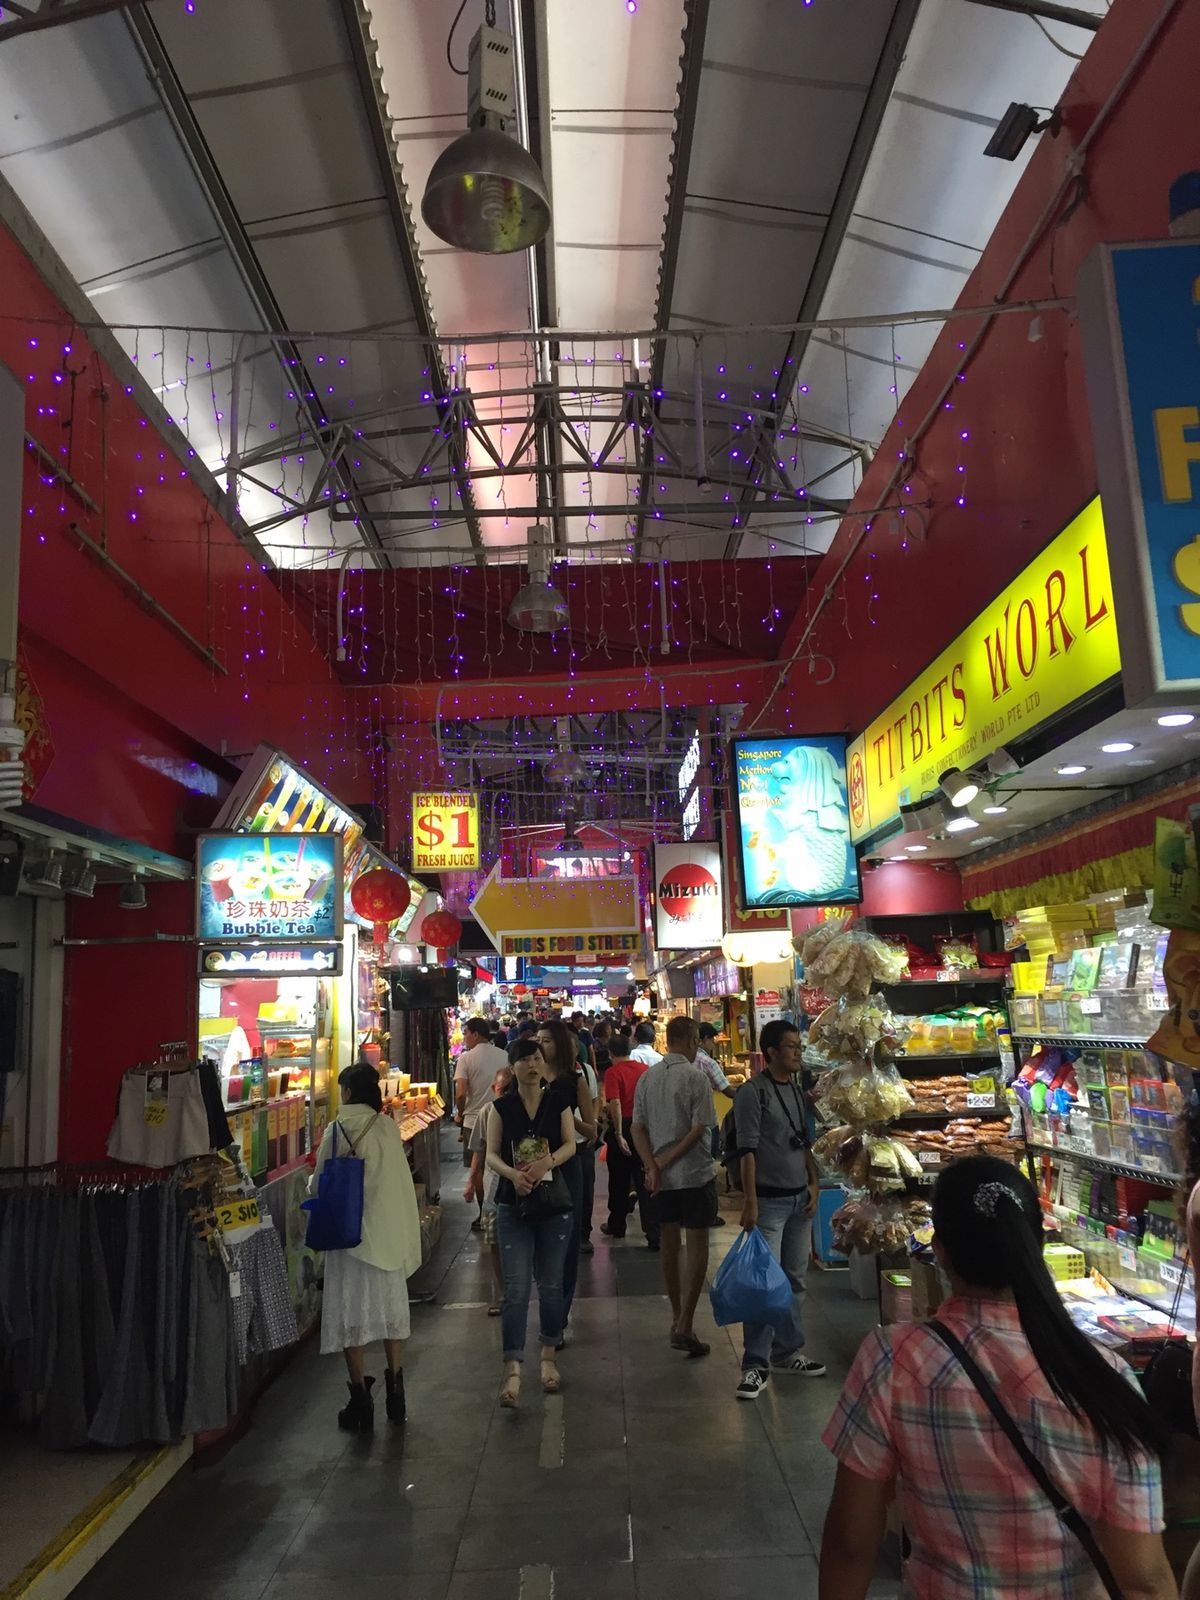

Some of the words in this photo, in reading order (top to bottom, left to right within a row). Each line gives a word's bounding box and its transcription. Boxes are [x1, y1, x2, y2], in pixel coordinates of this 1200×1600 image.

[872, 662, 967, 788] TITBITS
[981, 716, 1005, 743] WORLD
[1007, 704, 1022, 725] PTE
[1024, 691, 1041, 713] LTD
[738, 749, 782, 761] Singapore
[416, 795, 431, 808] ICE
[416, 810, 475, 851] $1
[417, 854, 446, 866] FRESH
[448, 854, 475, 866] JUICE
[659, 882, 718, 898] Mizuki
[226, 899, 311, 918] 珍珠奶茶
[313, 907, 330, 921] $2
[222, 922, 281, 934] Bubble
[286, 921, 315, 934] Tea
[504, 936, 545, 953] BUGIS
[549, 935, 584, 952] FOOD
[588, 933, 639, 950] STREET
[221, 1209, 232, 1225] 2
[239, 1202, 258, 1222] $10
